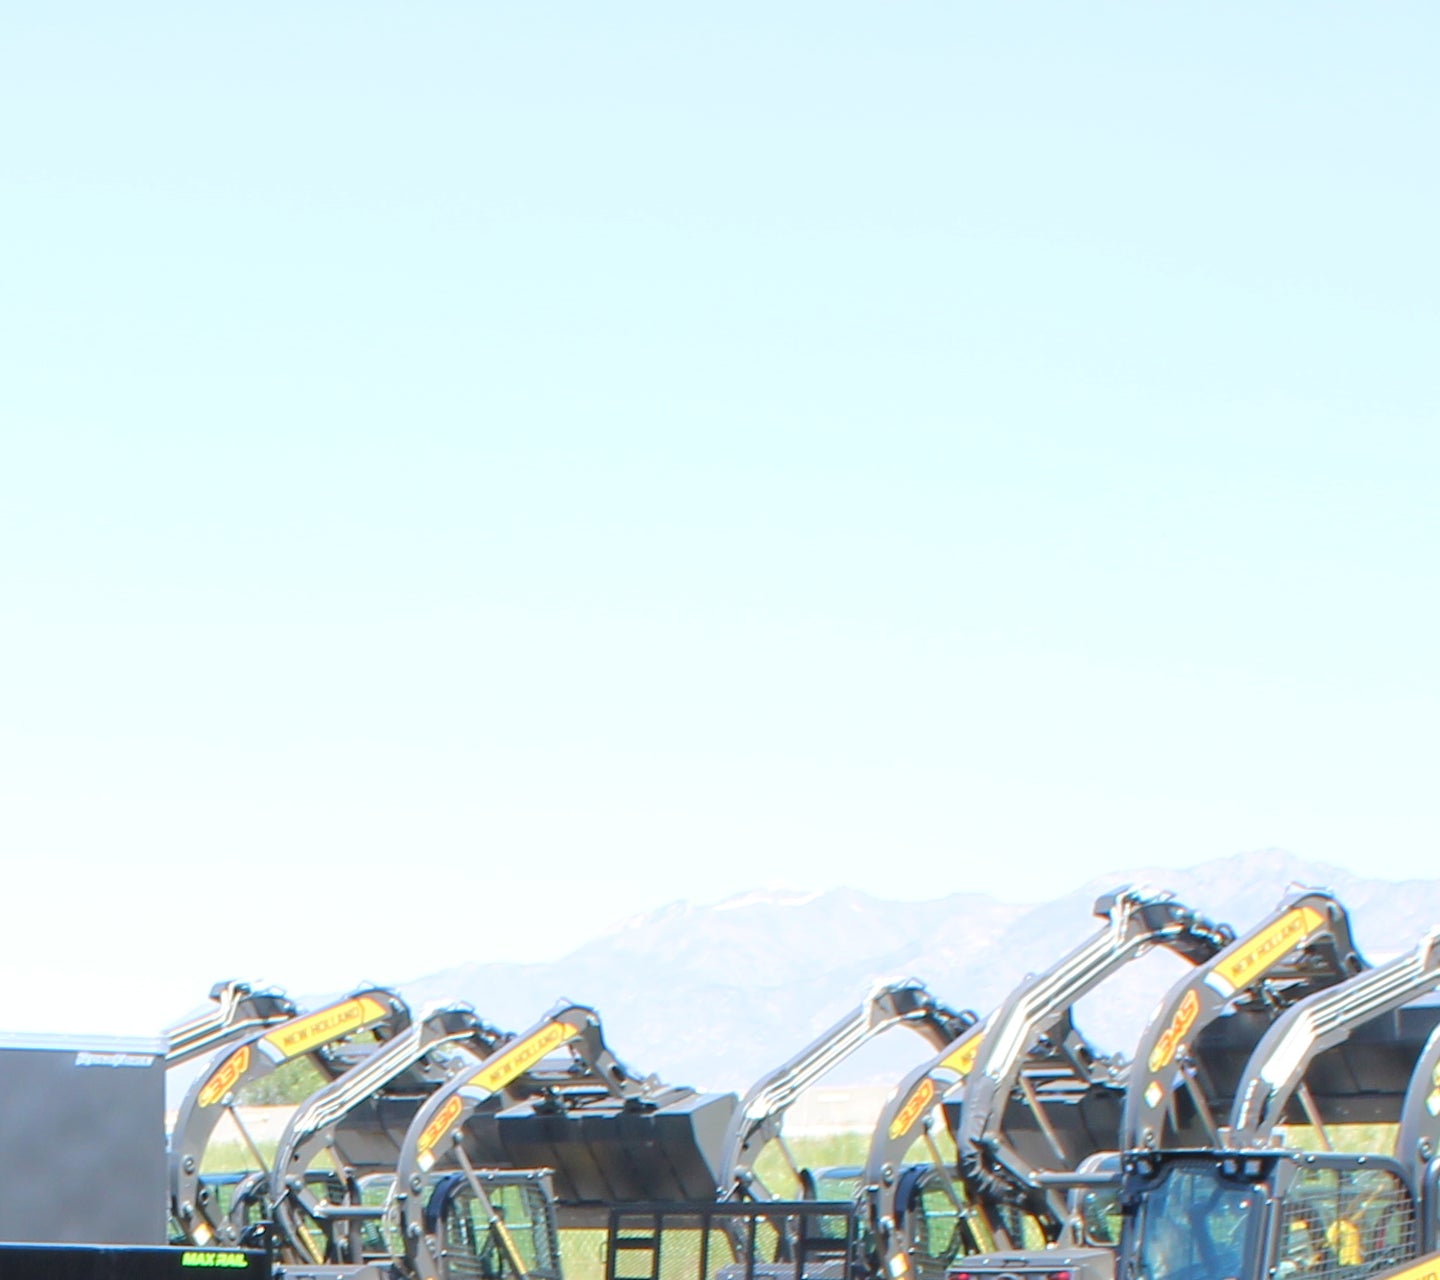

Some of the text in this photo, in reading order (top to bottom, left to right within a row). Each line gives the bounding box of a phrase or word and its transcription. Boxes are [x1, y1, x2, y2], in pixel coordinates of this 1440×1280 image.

[282, 1006, 361, 1048] NEW HOLLAND
[489, 1028, 559, 1085] NEW HOLLAND
[182, 1252, 248, 1269] MAX RAIL
